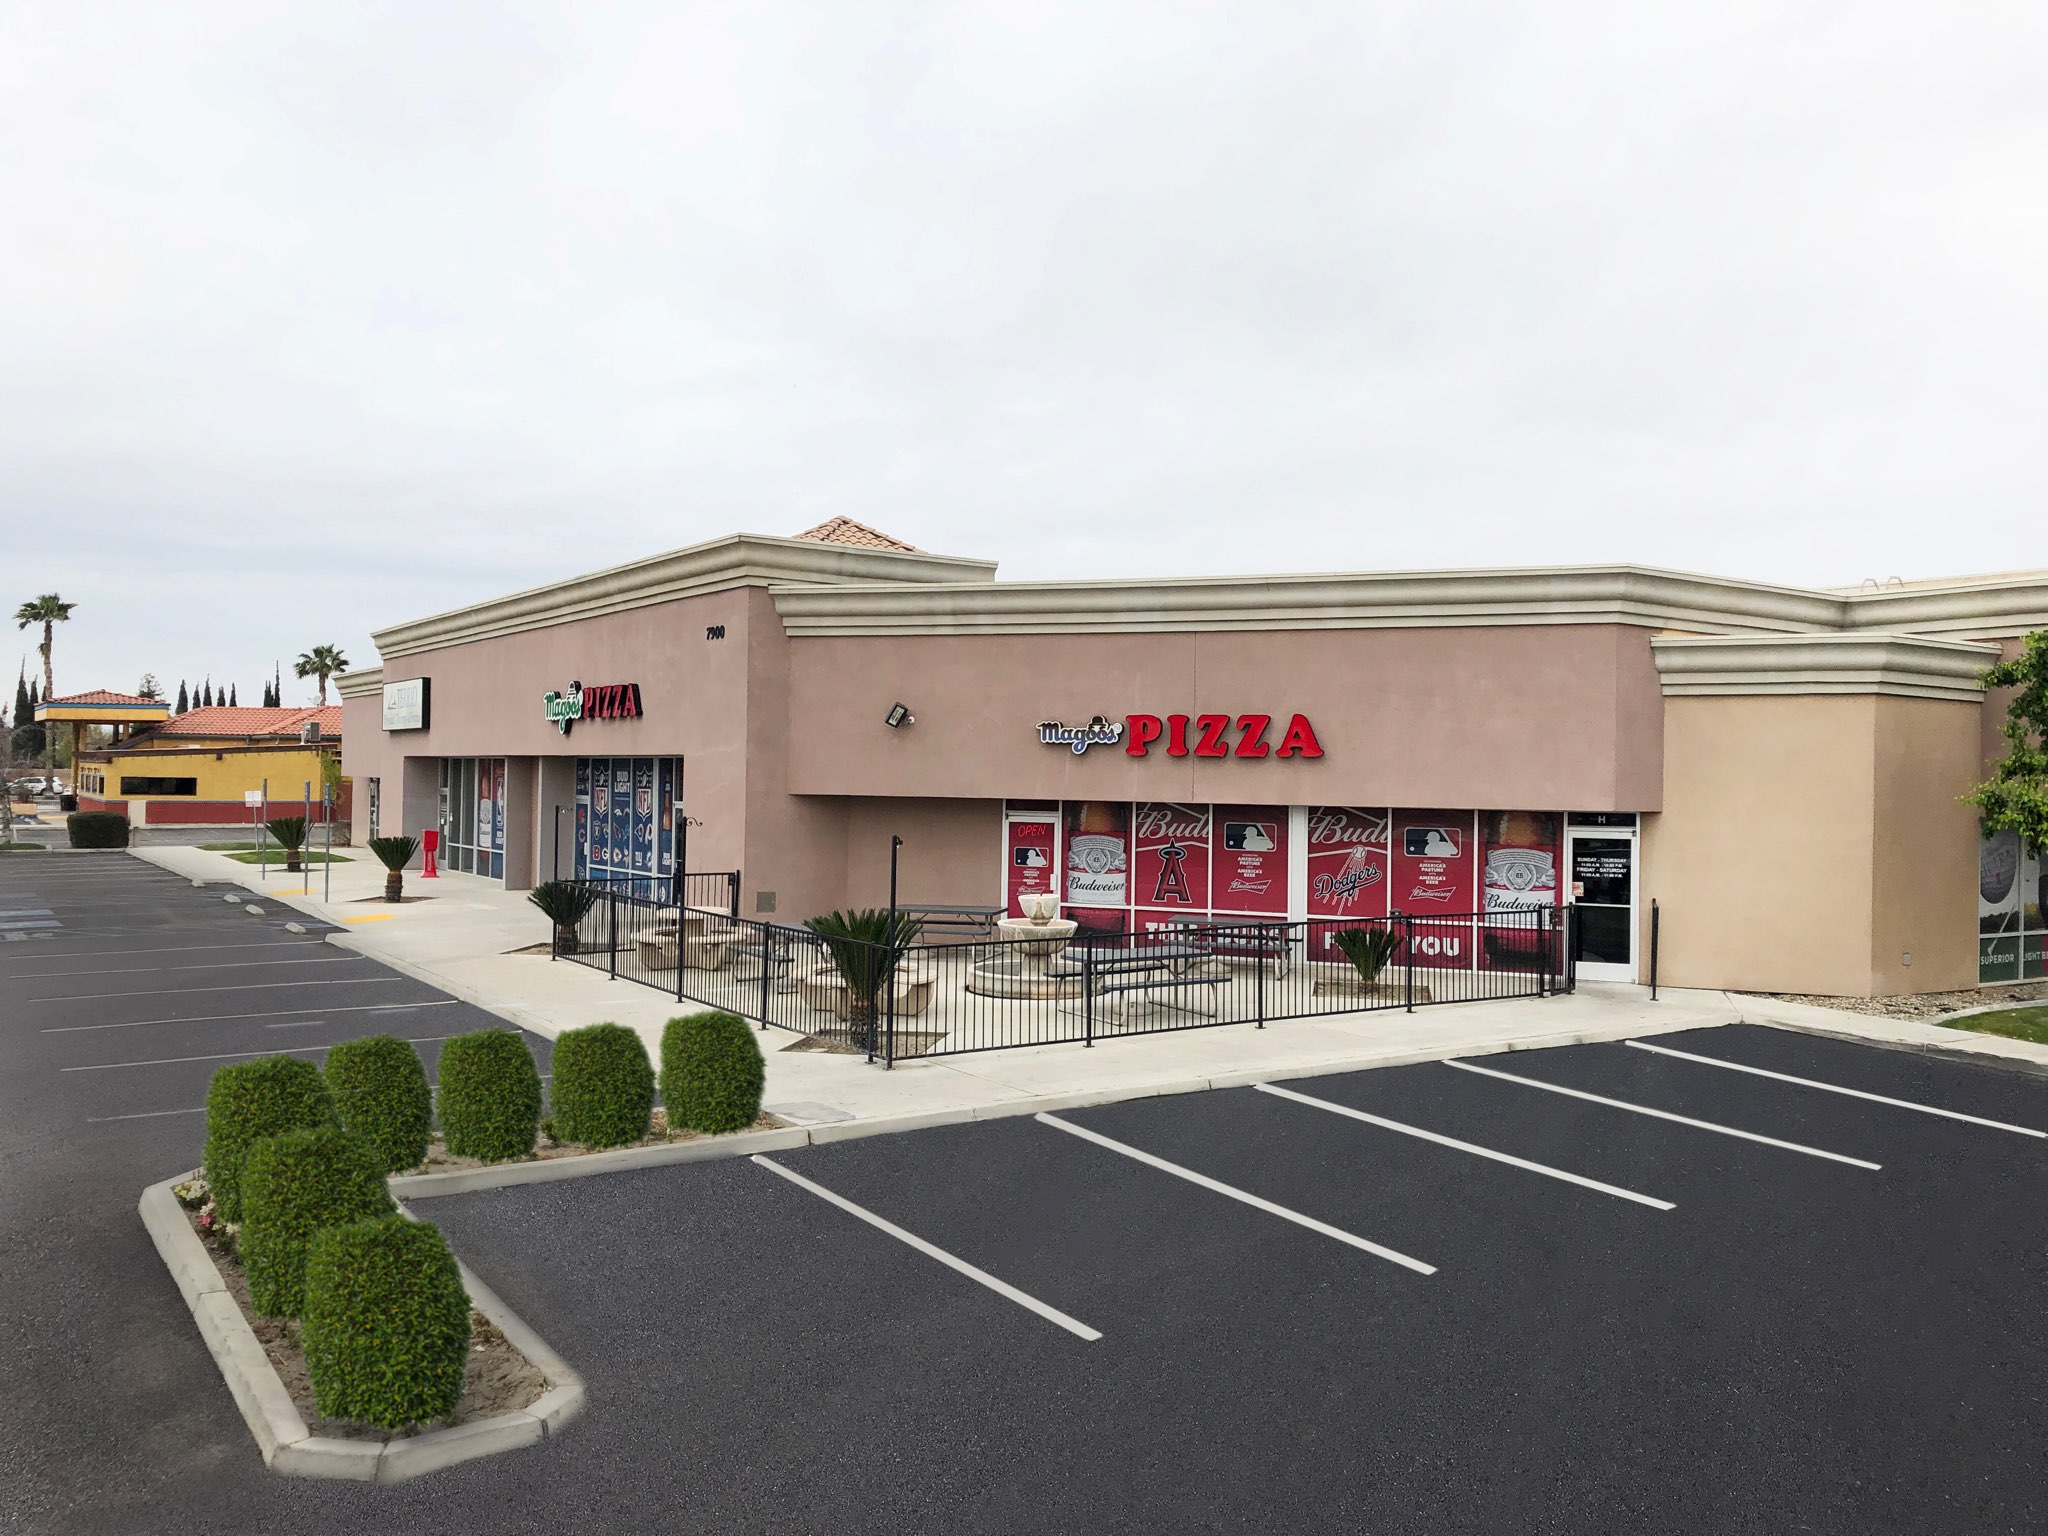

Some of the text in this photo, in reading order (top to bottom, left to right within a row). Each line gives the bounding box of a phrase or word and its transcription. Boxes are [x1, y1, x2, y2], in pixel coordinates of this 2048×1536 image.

[706, 625, 725, 640] 7900
[584, 683, 638, 719] PIZZA
[1125, 714, 1325, 758] PIZZA
[617, 771, 629, 781] BUD
[615, 782, 630, 793] LIGHT
[1598, 816, 1606, 824] H
[1017, 825, 1046, 837] OPEN
[1068, 876, 1125, 892] Budweiser
[1314, 863, 1382, 899] Dodgers
[1980, 954, 2015, 965] SUPERIOR
